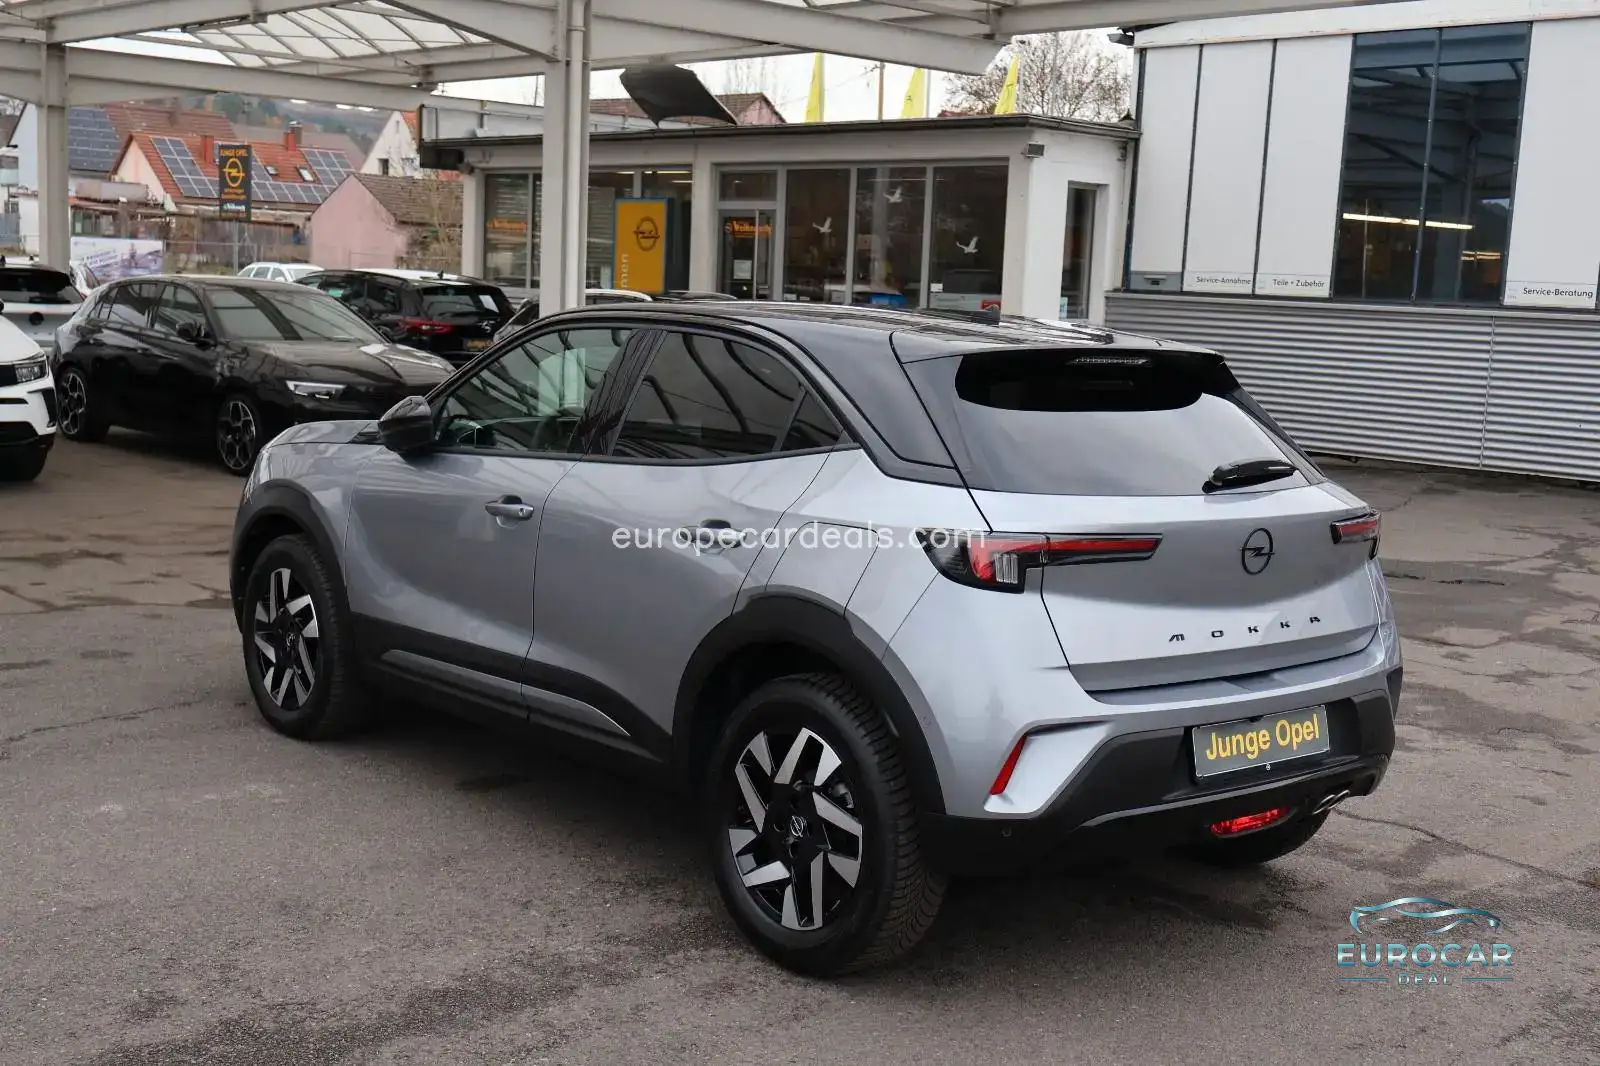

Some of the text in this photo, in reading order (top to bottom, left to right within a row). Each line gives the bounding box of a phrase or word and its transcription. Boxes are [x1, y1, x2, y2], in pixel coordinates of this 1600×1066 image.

[1196, 276, 1252, 285] Service-Annahme
[1295, 279, 1325, 288] Zubehör
[1523, 287, 1594, 299] Service-Beratung
[1168, 616, 1321, 643] MOKKA
[1206, 713, 1320, 760] Junge Opel
